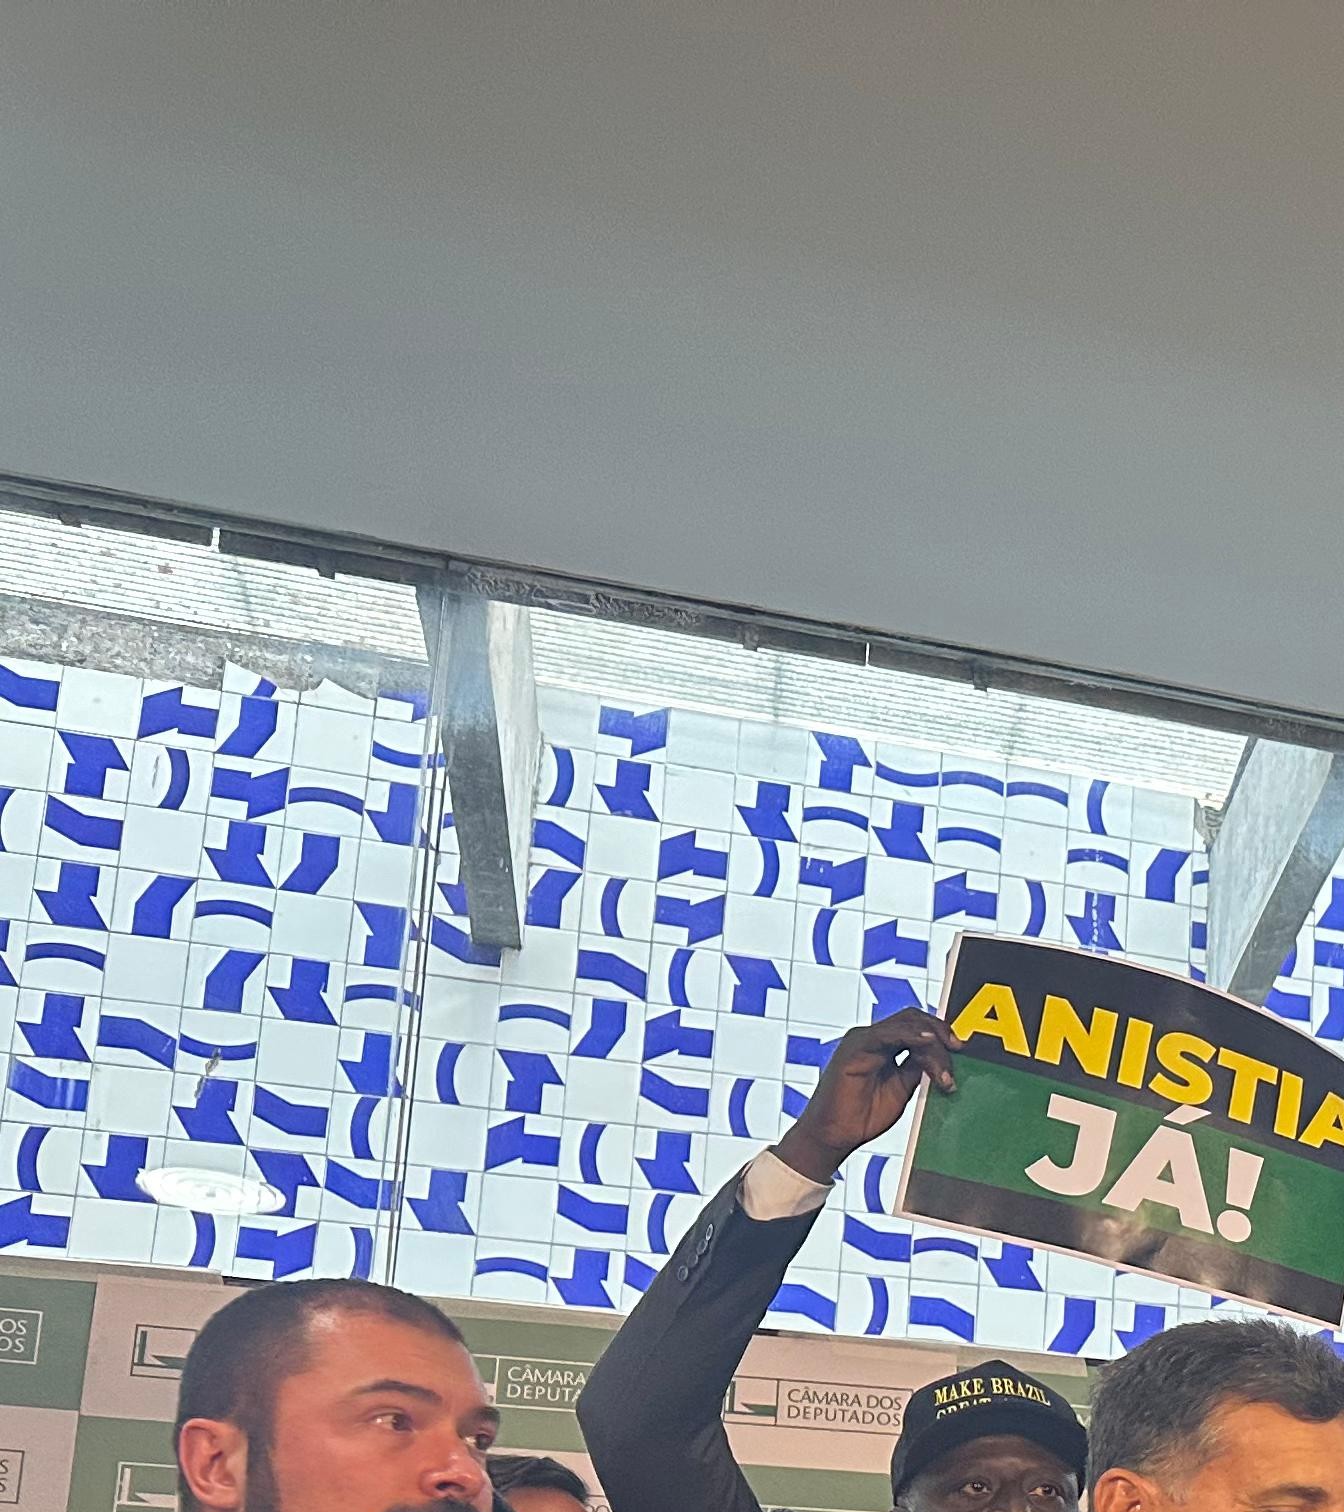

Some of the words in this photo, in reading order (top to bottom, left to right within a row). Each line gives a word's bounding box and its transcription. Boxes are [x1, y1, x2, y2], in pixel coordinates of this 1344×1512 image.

[1024, 1094, 1264, 1243] JÁ!
[0, 1318, 28, 1335] OS
[507, 1363, 587, 1386] CÂMARA
[506, 1383, 582, 1402] DEPUT
[787, 1386, 862, 1409] CÂMARA
[866, 1394, 902, 1412] DOS
[934, 1377, 985, 1406] MAKE
[990, 1377, 1051, 1408] BRAZIL
[787, 1404, 901, 1427] DEPUTADOS
